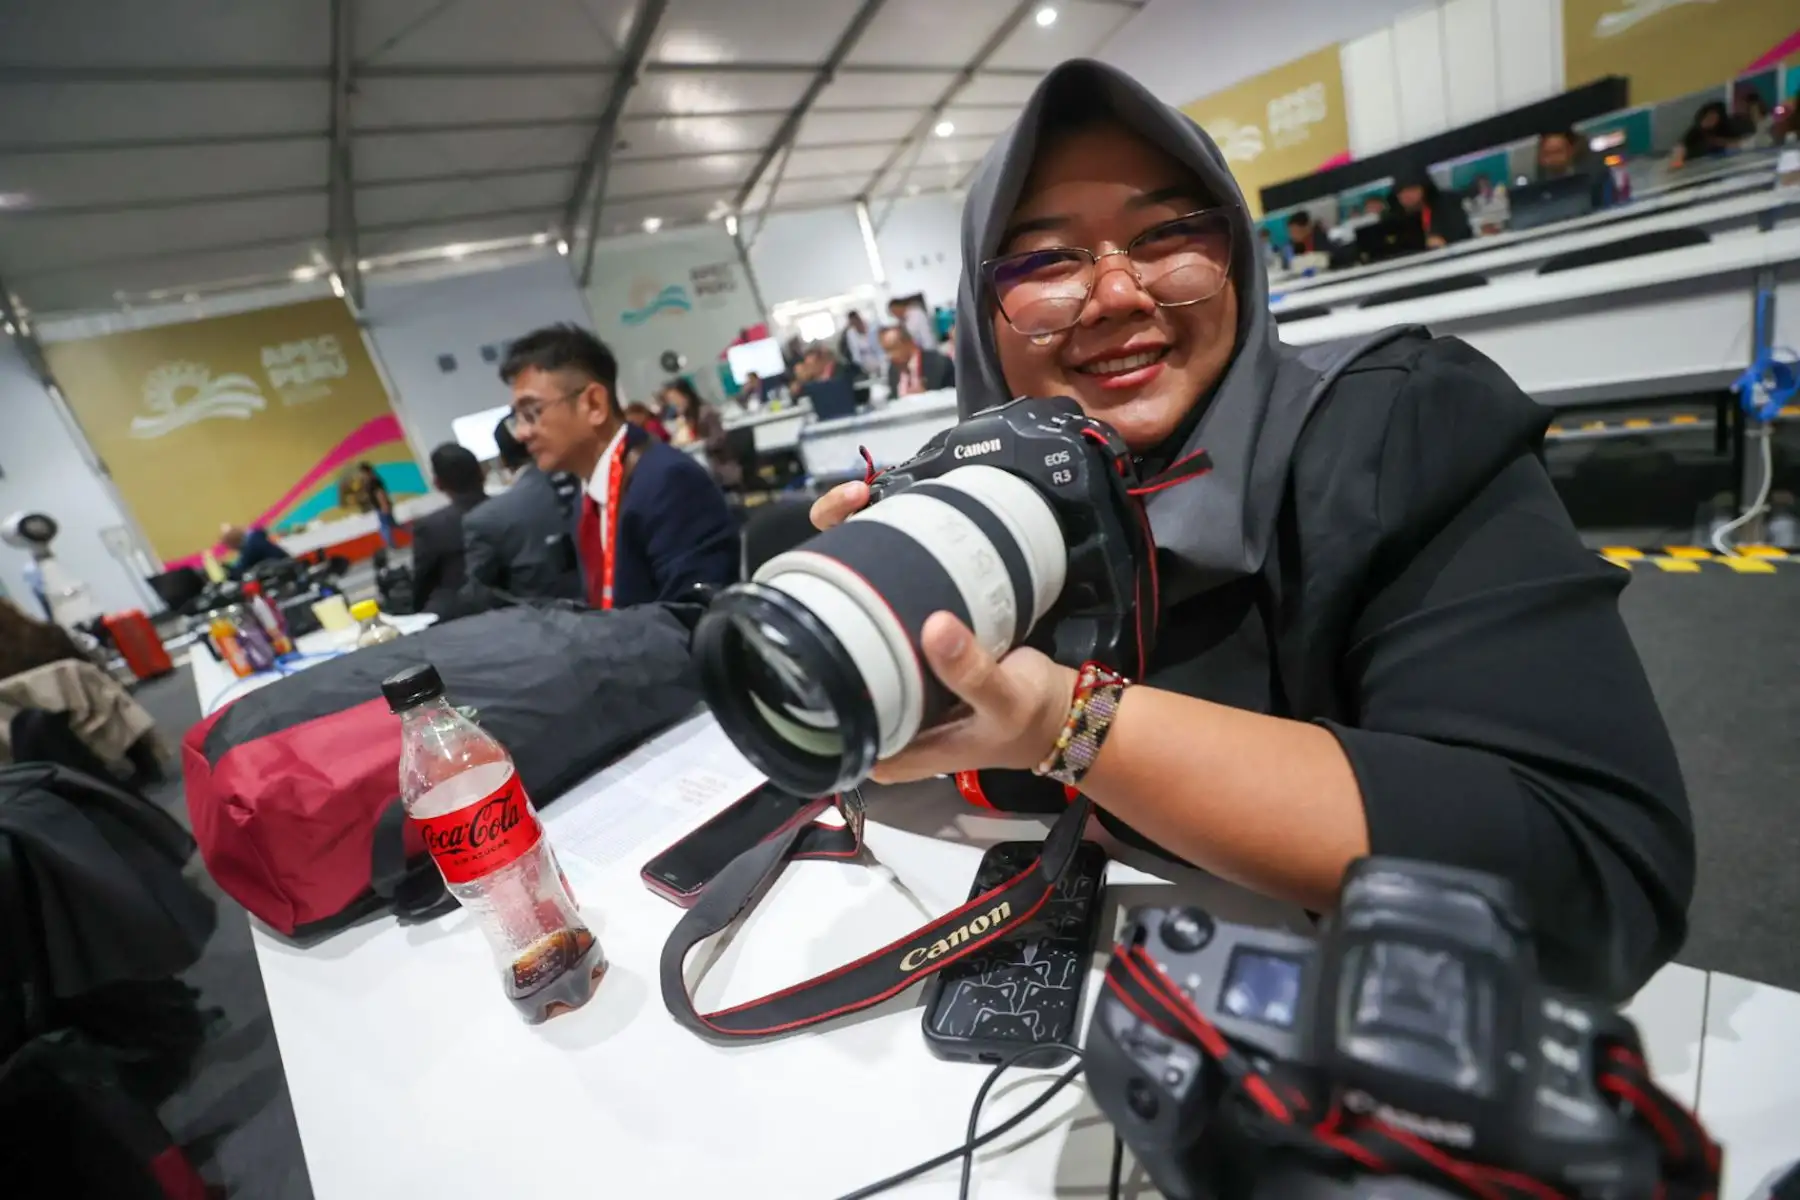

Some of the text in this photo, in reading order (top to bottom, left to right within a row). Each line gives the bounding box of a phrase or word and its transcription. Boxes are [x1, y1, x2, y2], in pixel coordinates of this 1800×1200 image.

[953, 438, 1002, 460] Canon
[1044, 450, 1070, 467] EOS
[1052, 469, 1072, 485] R3
[421, 789, 521, 857] Coca-Cola
[899, 901, 1012, 972] Canon
